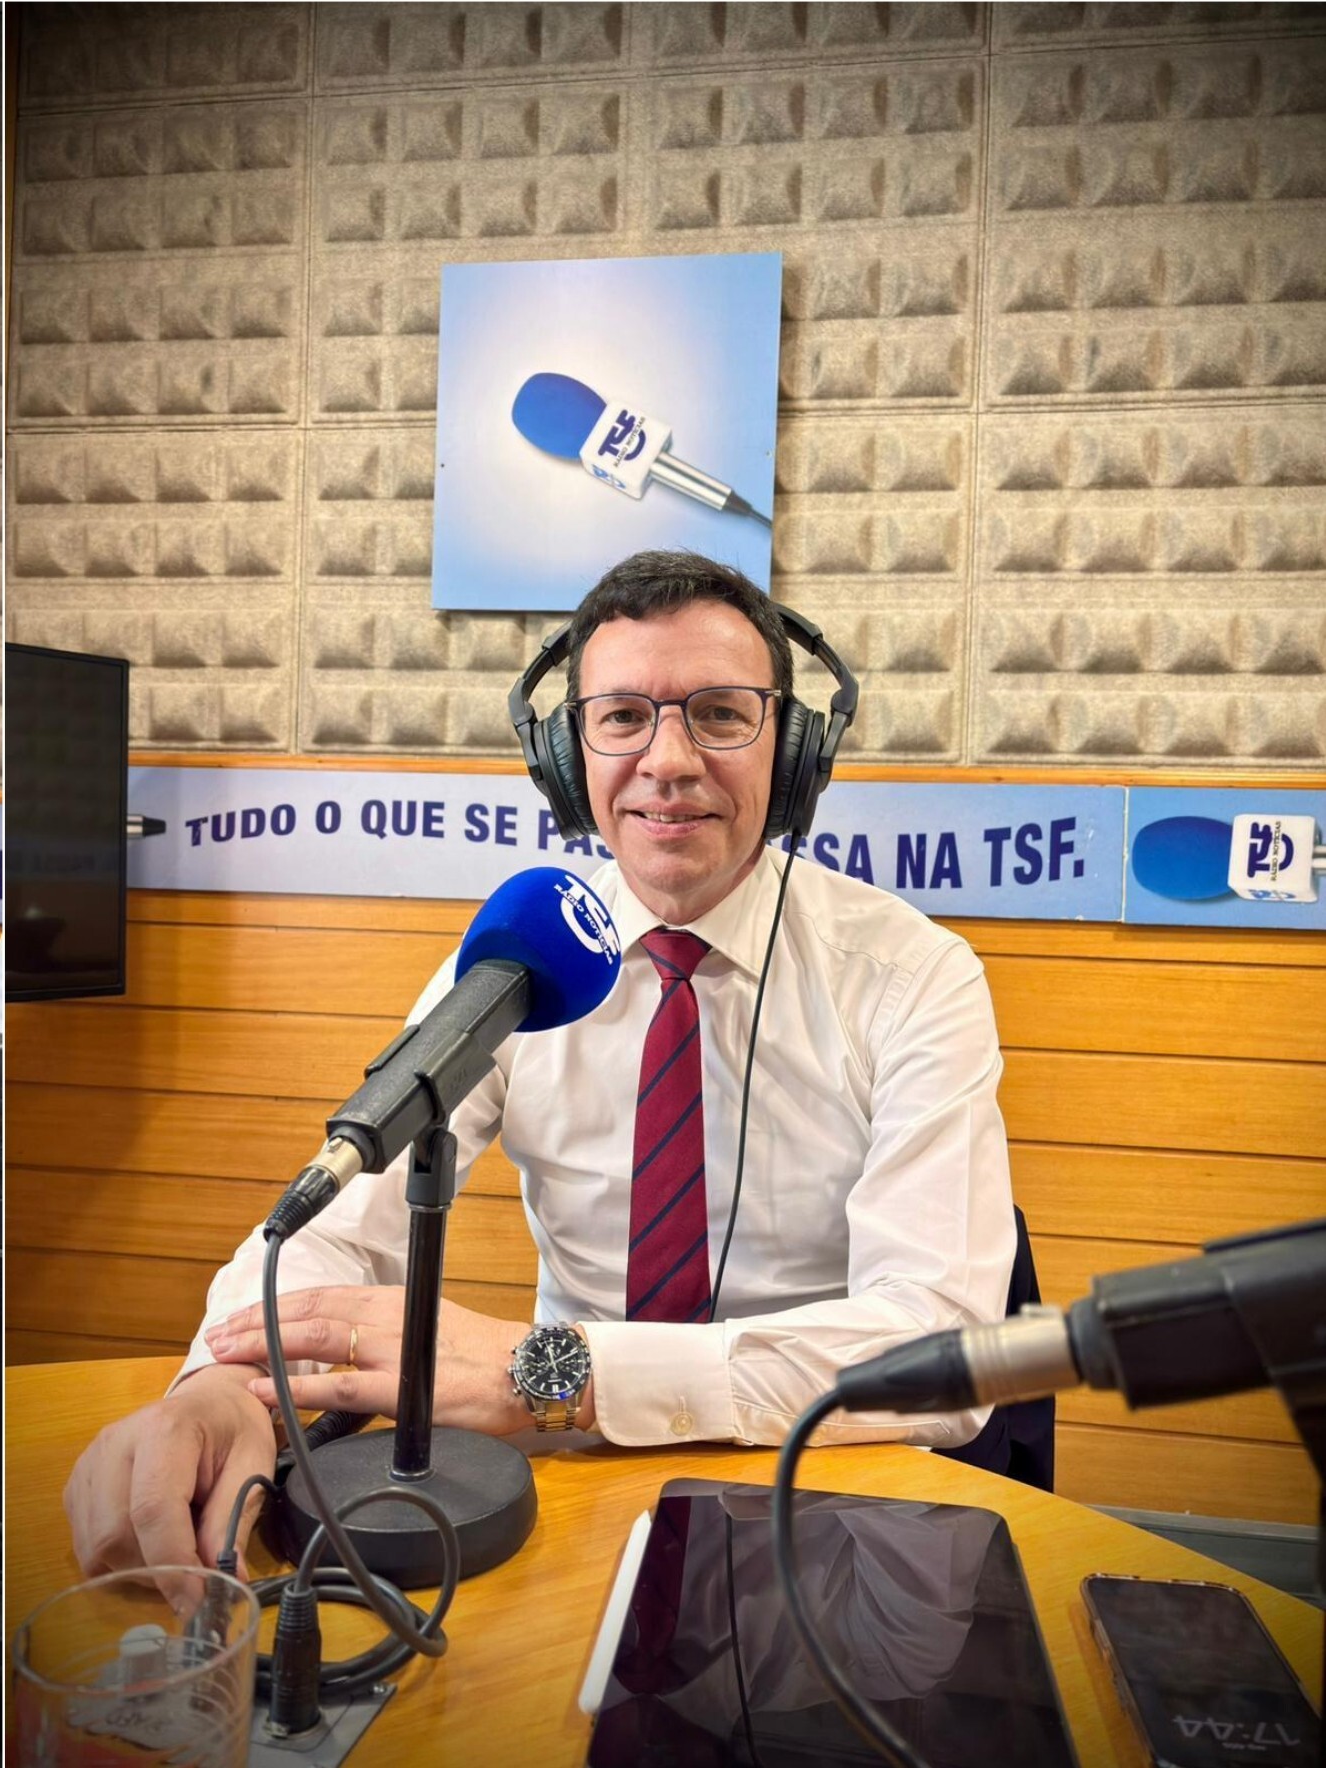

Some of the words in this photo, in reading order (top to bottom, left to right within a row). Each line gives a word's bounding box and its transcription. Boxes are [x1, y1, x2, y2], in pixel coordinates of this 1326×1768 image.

[598, 409, 636, 457] TSF
[185, 803, 296, 847] TUDO
[315, 800, 342, 835] O
[361, 799, 445, 840] QUE
[464, 803, 518, 847] SE
[896, 831, 963, 889] NA
[983, 816, 1085, 888] TSF.
[564, 874, 621, 956] TSF
[1172, 1714, 1301, 1747] 17:44
